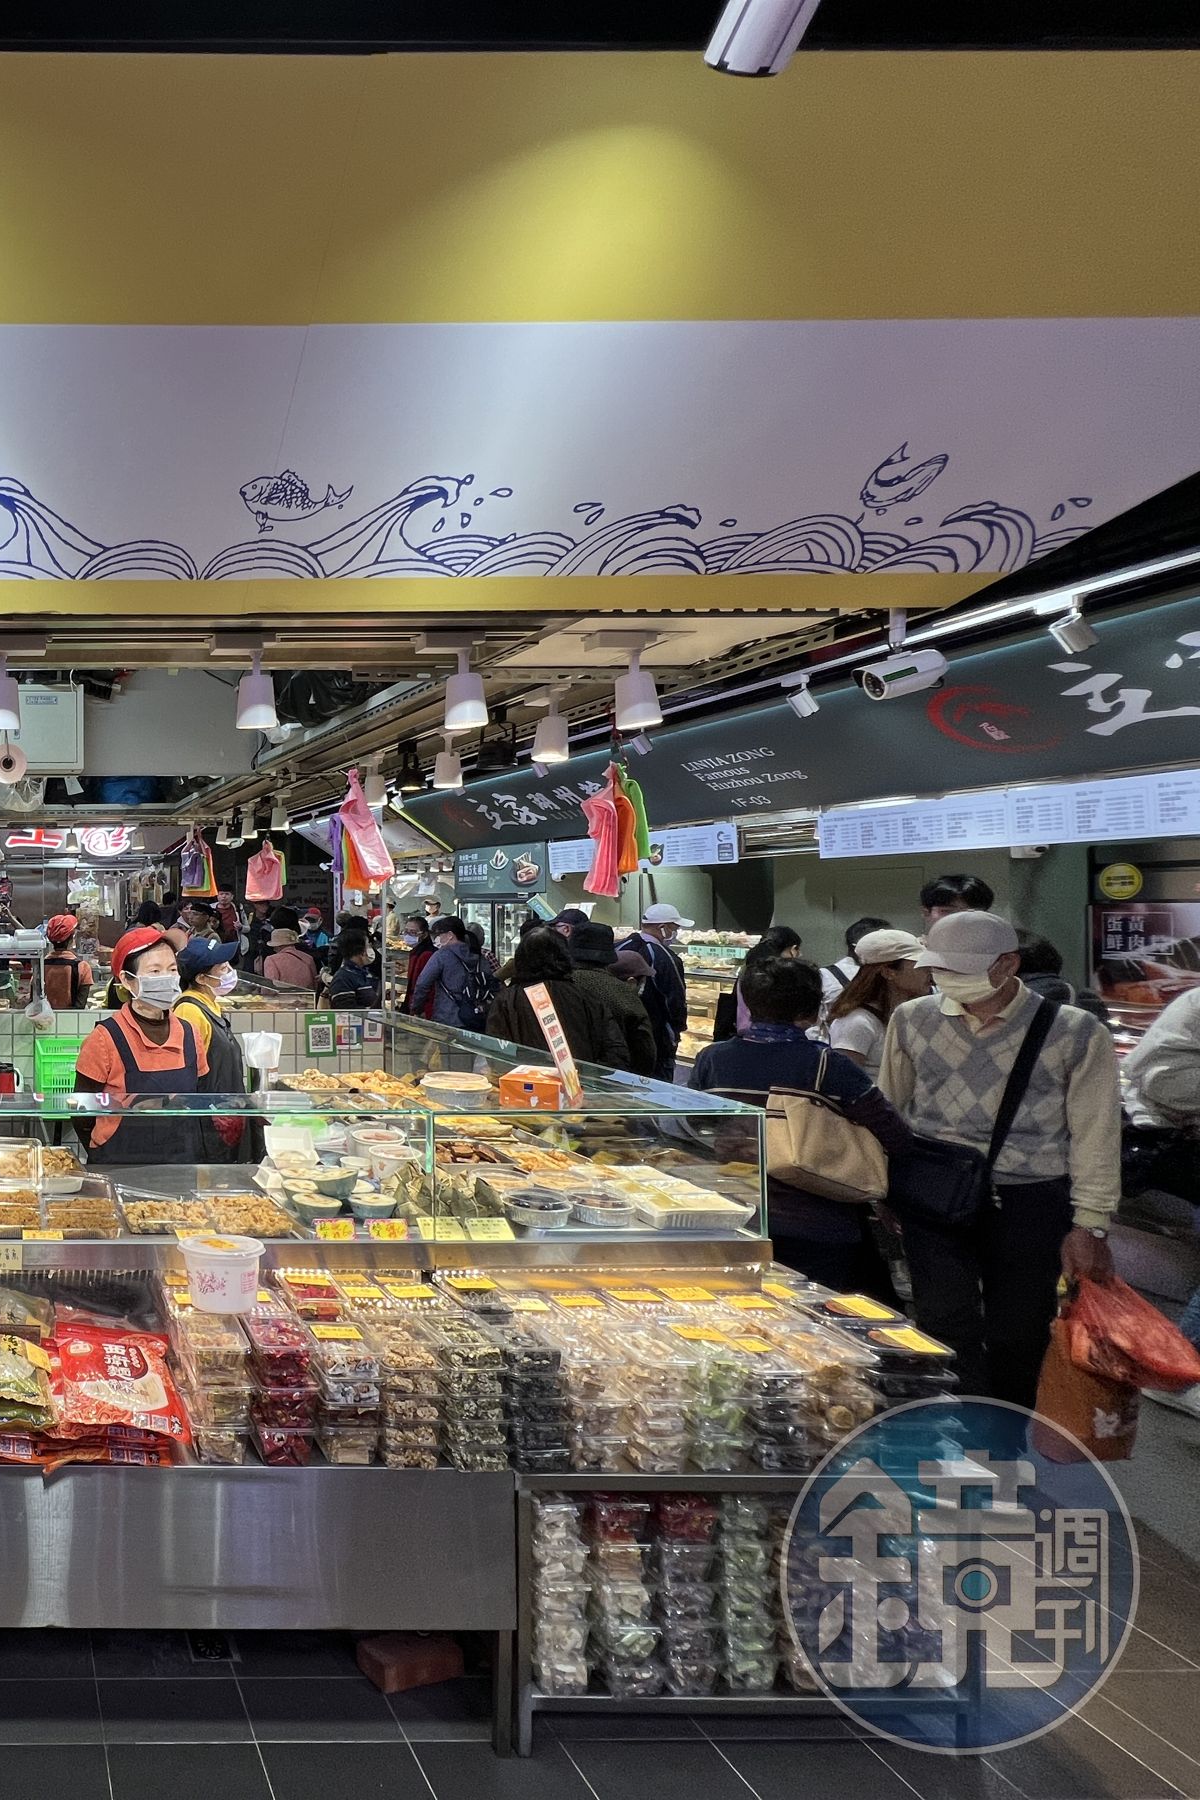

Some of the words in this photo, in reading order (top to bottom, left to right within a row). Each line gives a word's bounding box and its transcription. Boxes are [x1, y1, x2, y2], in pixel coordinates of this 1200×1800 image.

[726, 746, 776, 764] ZONG
[694, 766, 750, 782] Famous
[706, 776, 764, 791] Huzhou
[761, 769, 808, 783] Zong
[731, 795, 771, 807] 1F-03
